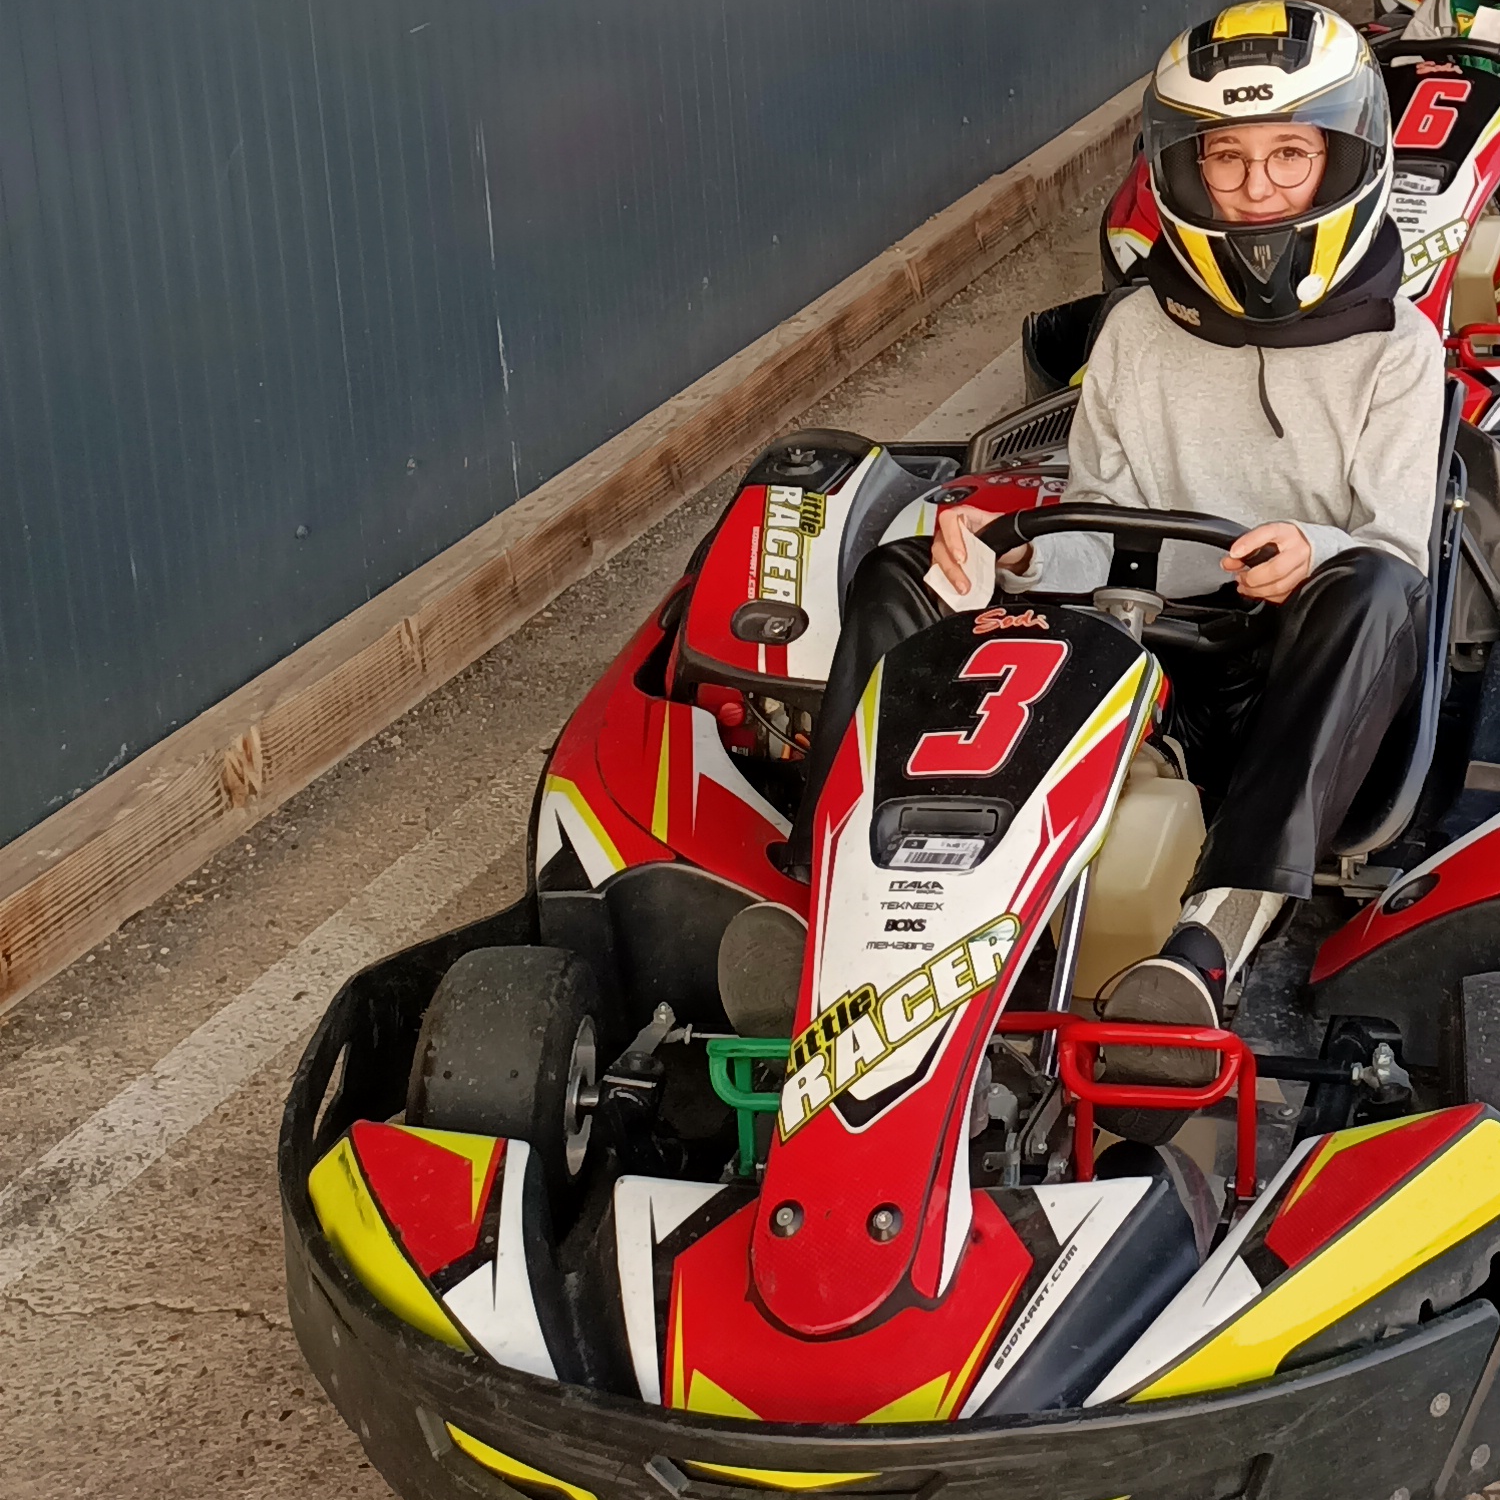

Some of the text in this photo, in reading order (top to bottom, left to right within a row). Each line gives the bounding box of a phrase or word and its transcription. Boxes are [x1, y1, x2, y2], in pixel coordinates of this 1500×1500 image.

[1223, 83, 1274, 105] BOXS
[1392, 77, 1472, 149] 6
[1402, 220, 1467, 277] CER
[801, 493, 822, 537] ittle
[763, 484, 803, 604] RACER
[972, 607, 1050, 634] Sodi
[905, 638, 1069, 776] 3
[880, 901, 945, 911] TEKNEEX
[889, 880, 944, 892] ITAKA
[884, 919, 927, 932] BOXS
[780, 918, 1017, 1133] RACER
[783, 990, 873, 1071] ittle
